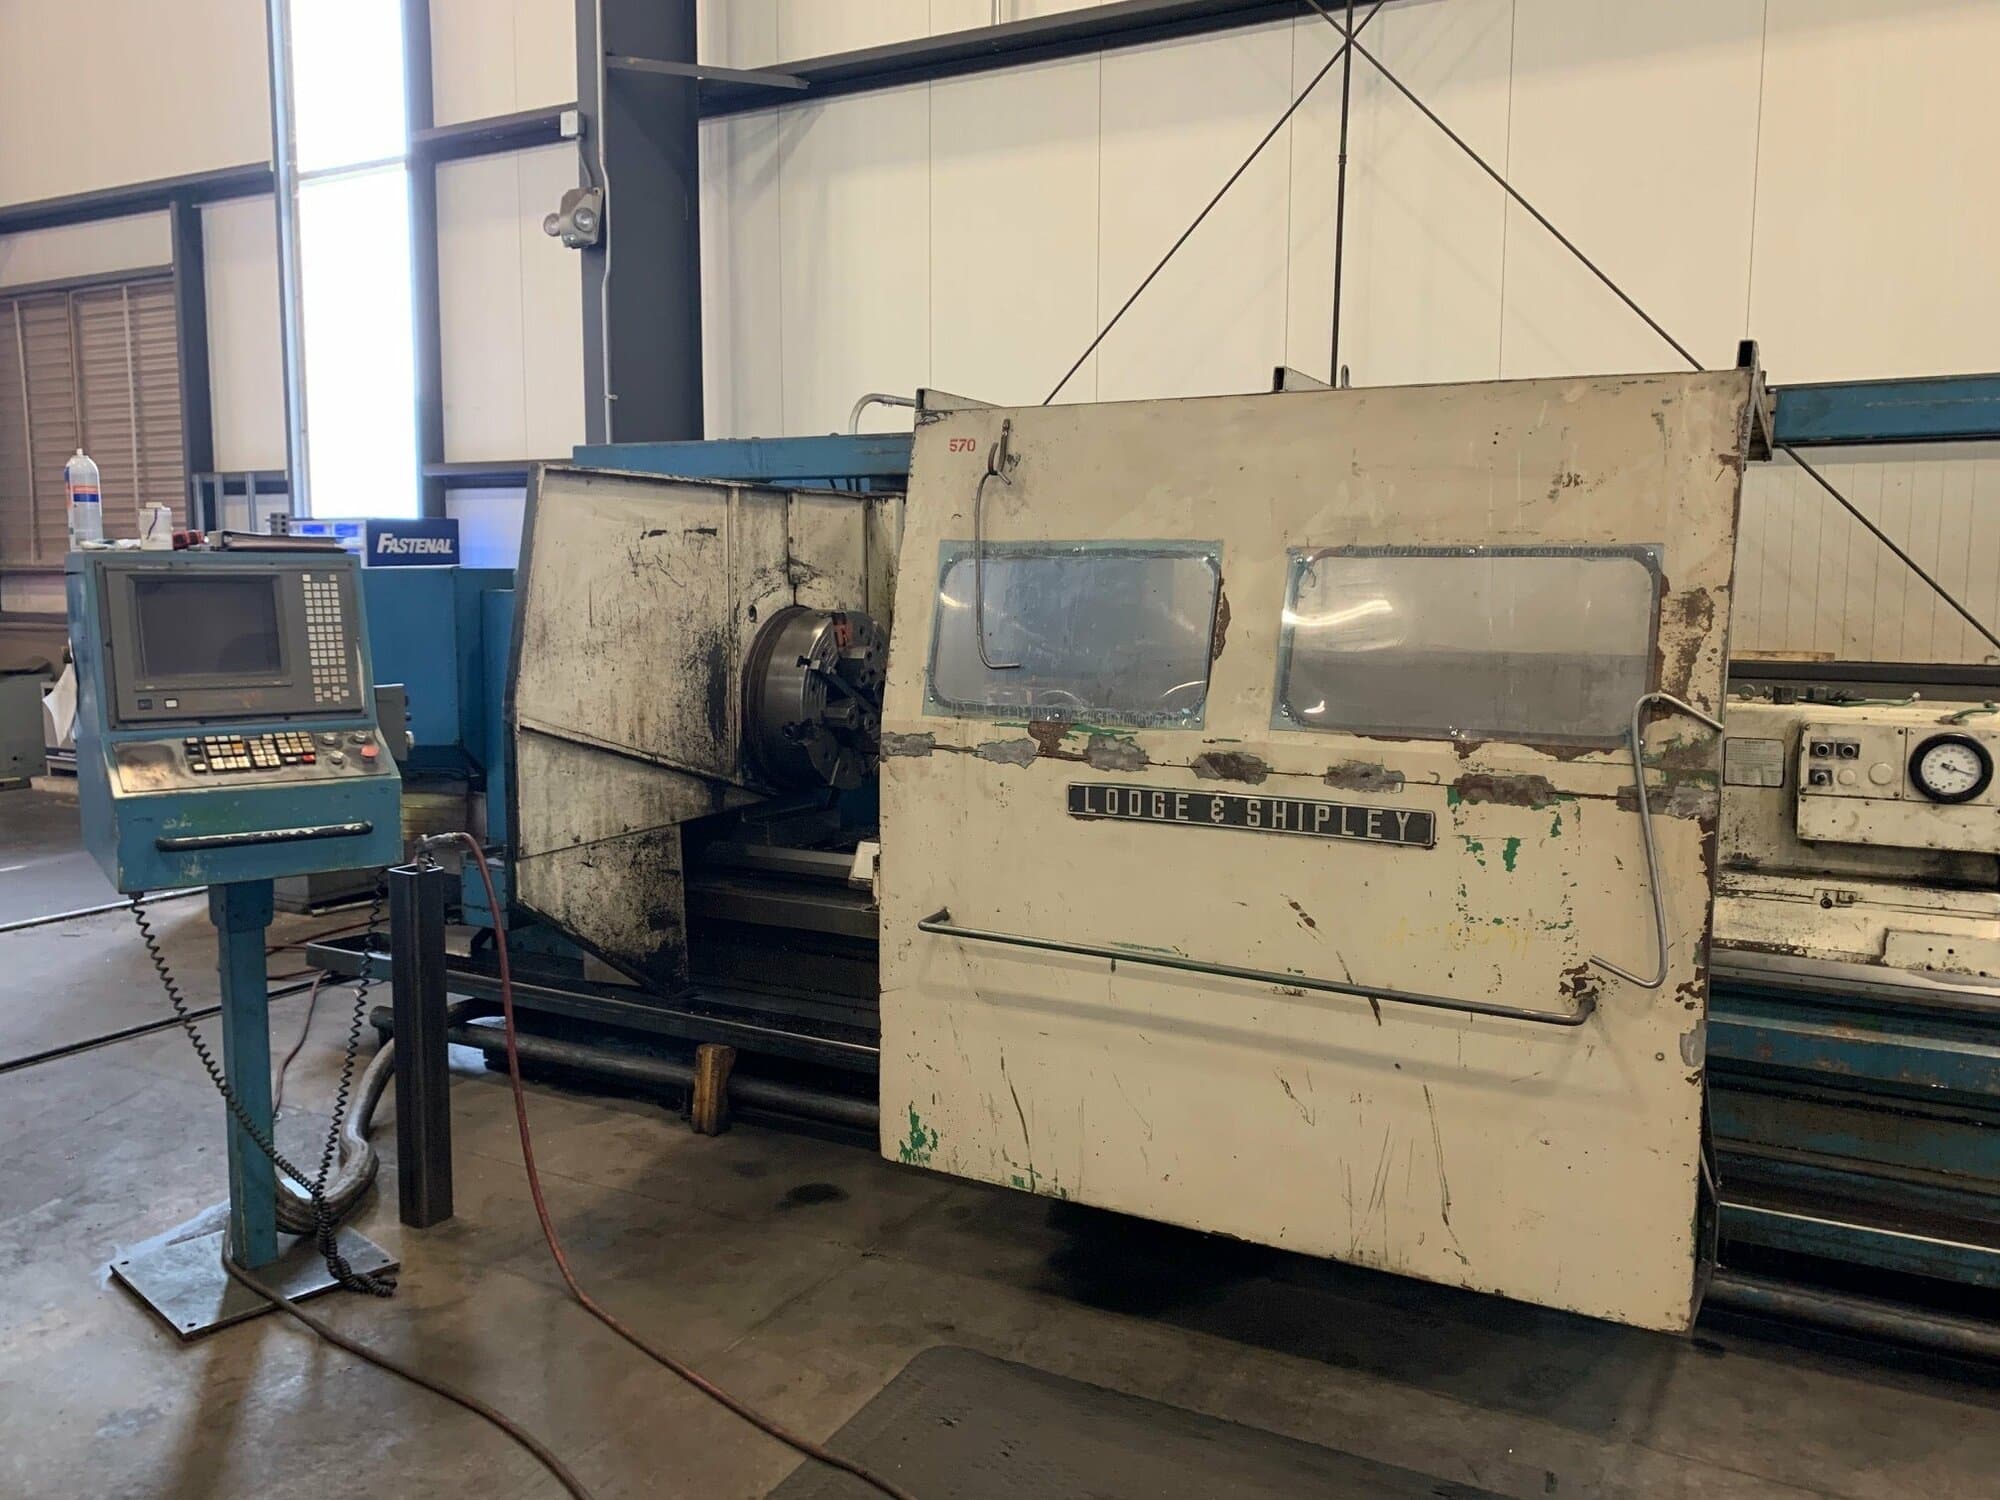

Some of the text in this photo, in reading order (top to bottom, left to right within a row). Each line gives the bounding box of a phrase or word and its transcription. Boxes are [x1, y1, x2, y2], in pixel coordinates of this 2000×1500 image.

[949, 438, 976, 452] 570
[377, 533, 453, 554] FASTENAL
[1083, 787, 1413, 841] LODGE & SHIPLEY
